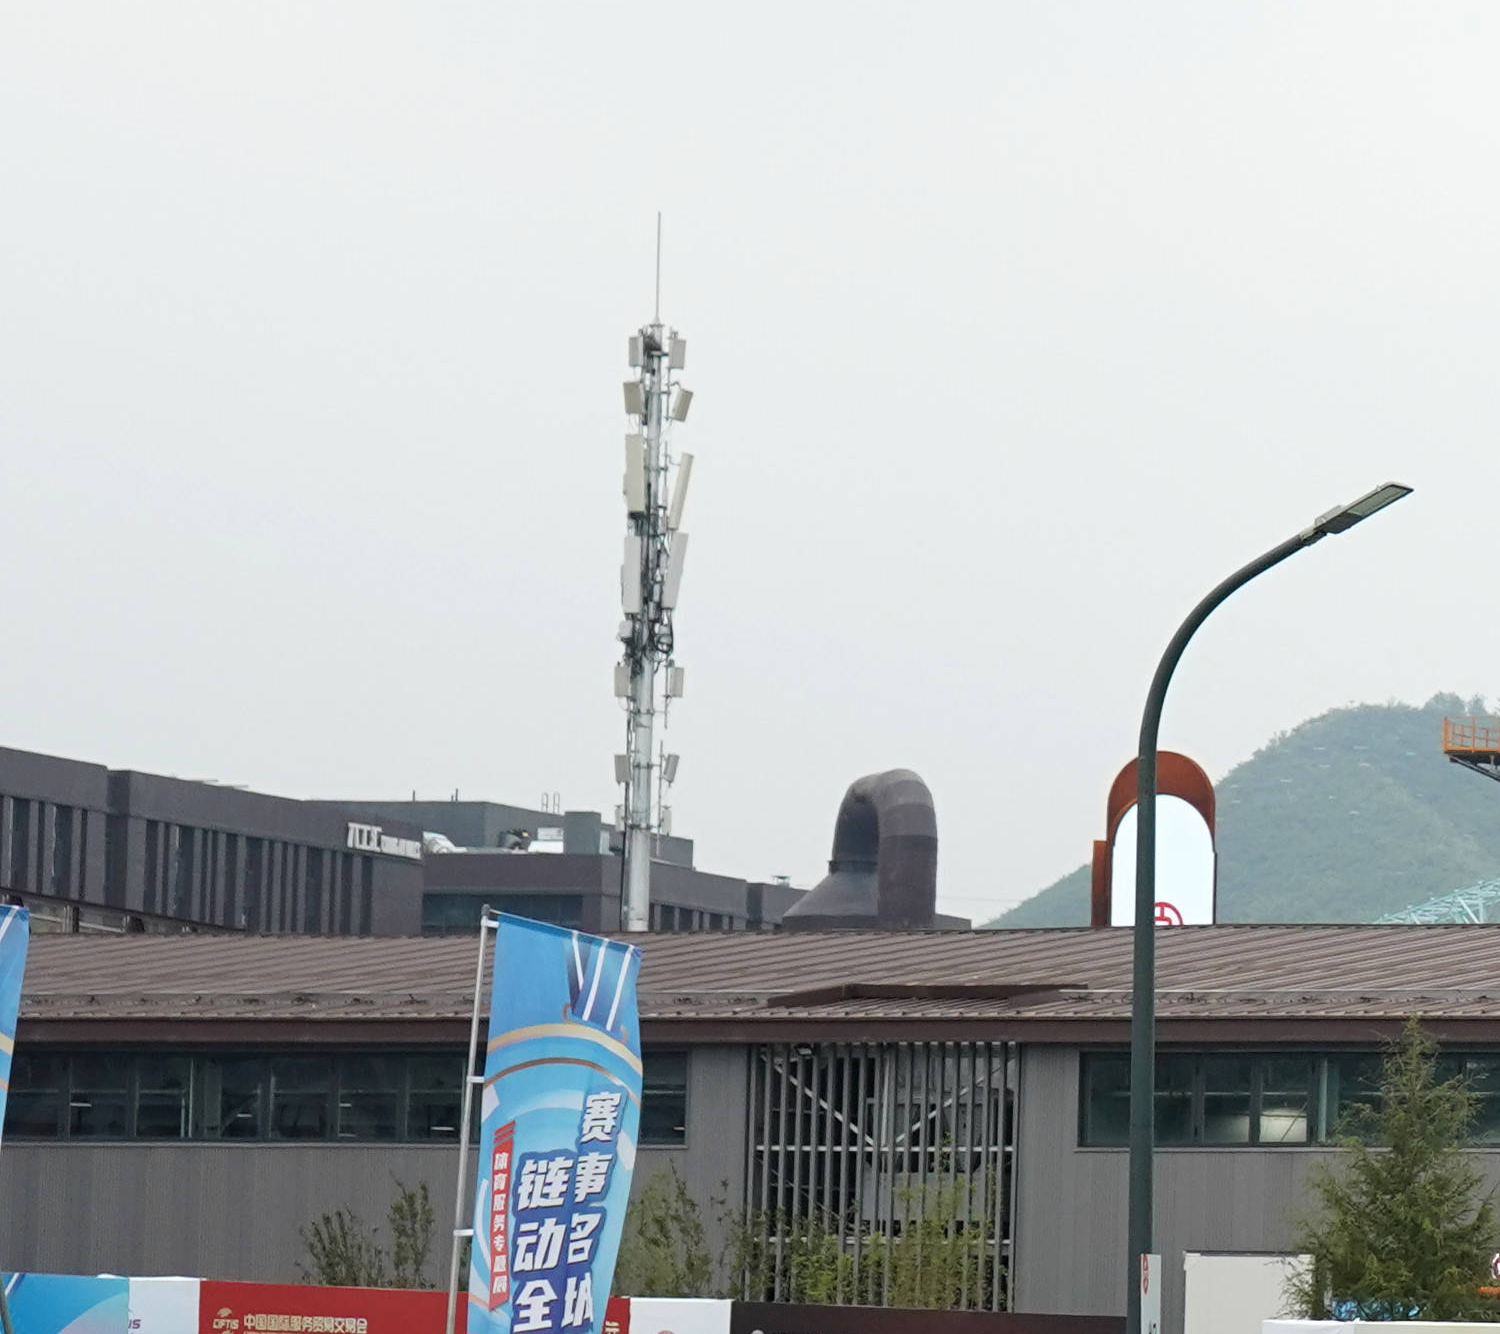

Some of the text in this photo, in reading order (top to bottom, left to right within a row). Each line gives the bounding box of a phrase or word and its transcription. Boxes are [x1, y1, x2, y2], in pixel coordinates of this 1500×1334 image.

[243, 1313, 368, 1334] 中国国际服务贸易交易会
